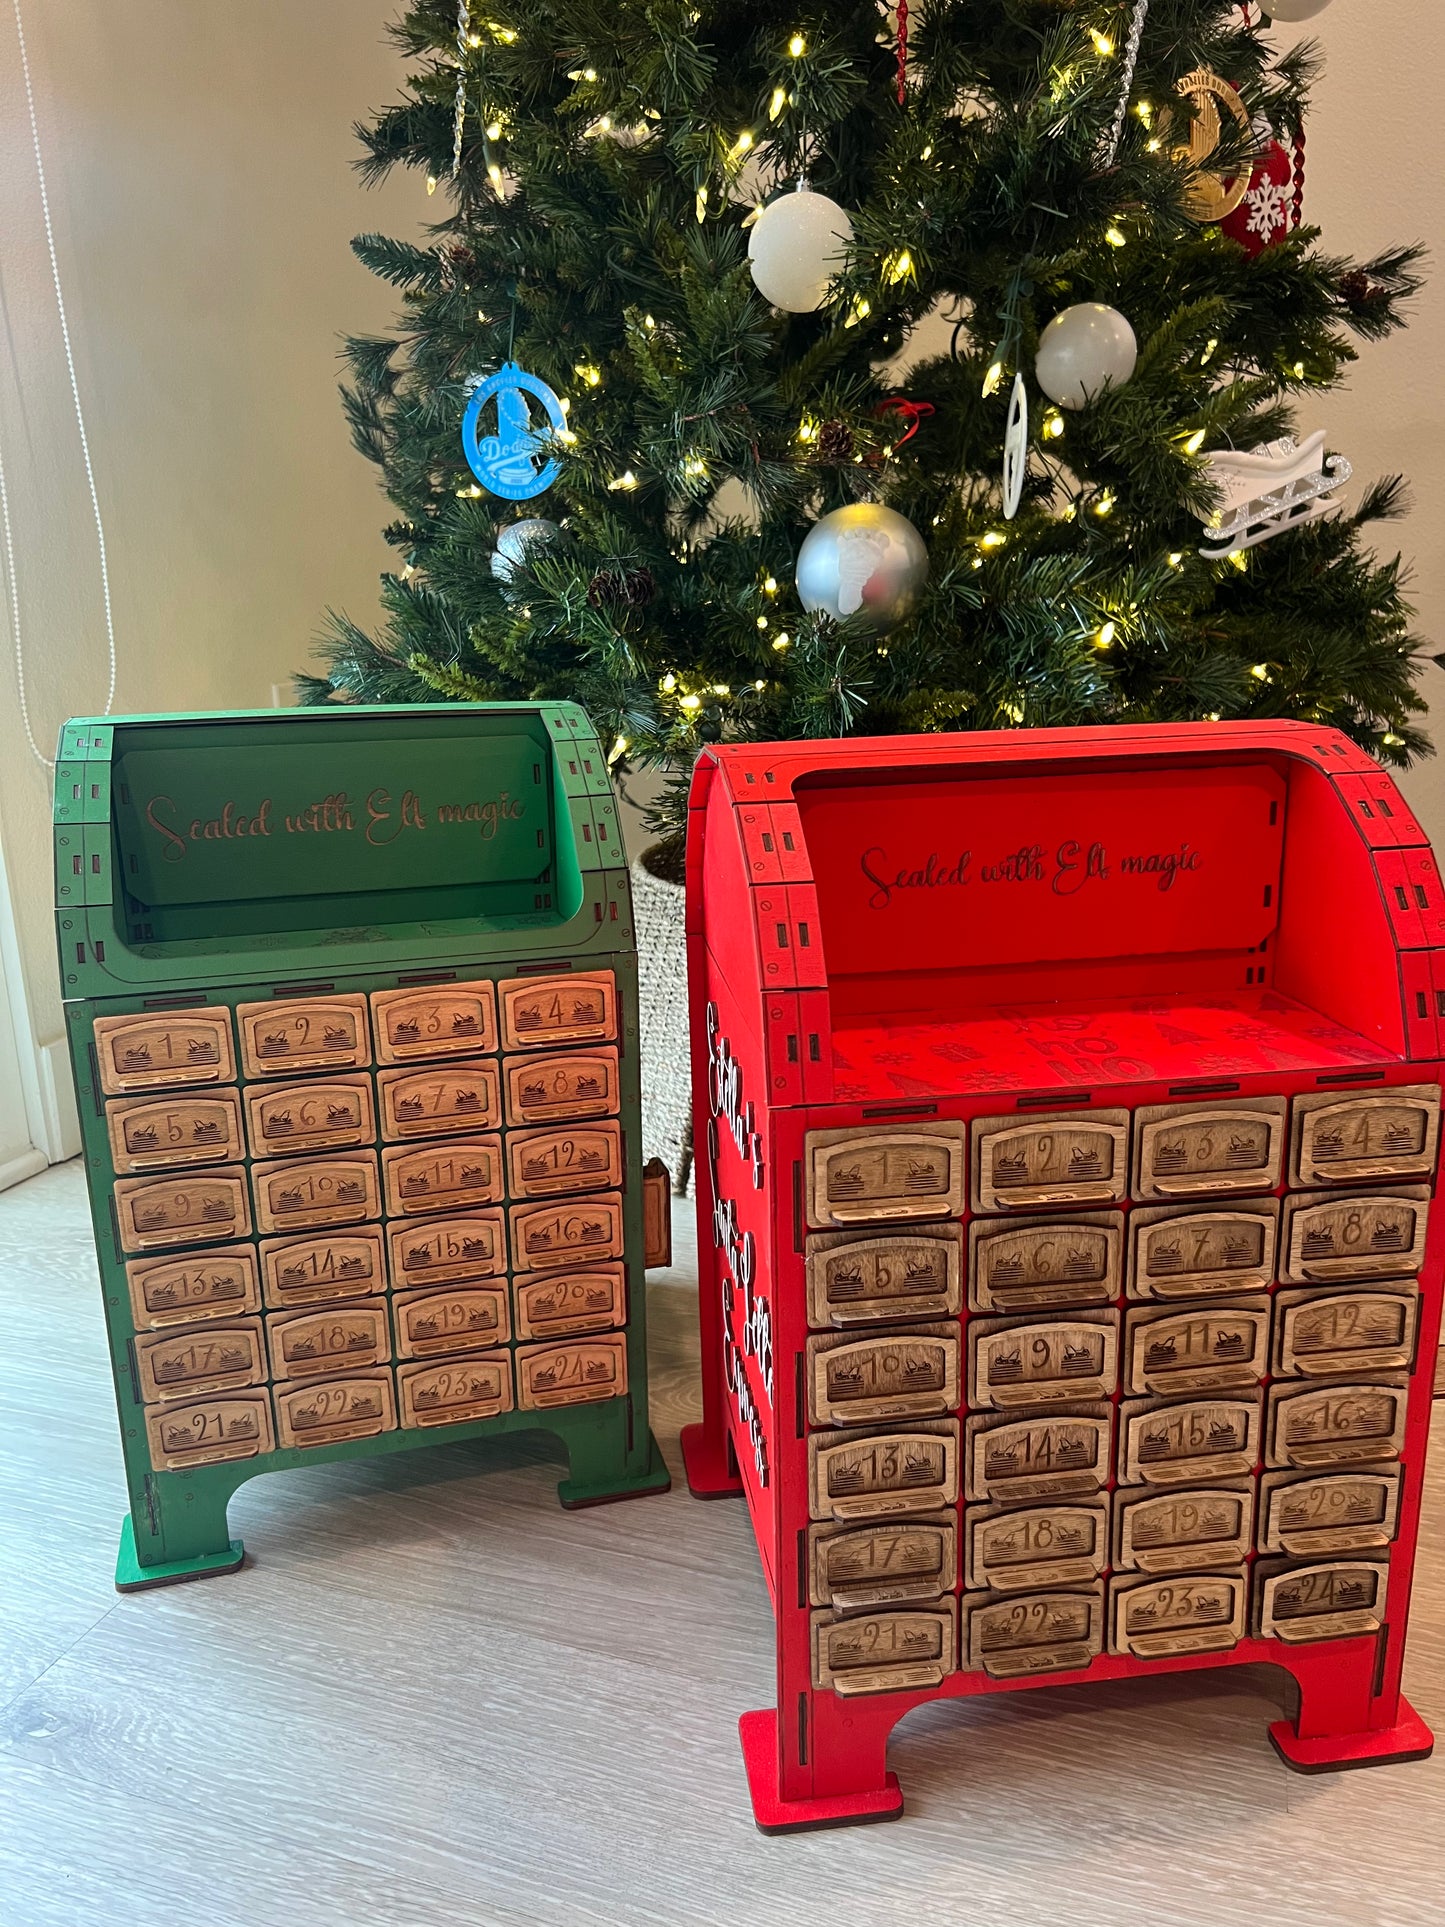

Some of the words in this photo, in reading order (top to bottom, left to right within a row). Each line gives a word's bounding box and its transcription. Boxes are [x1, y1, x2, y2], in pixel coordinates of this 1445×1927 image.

[146, 796, 274, 863] Sealed
[285, 792, 356, 833] with
[365, 788, 427, 846] Elf
[438, 792, 527, 841] magic
[861, 847, 972, 910] Sealed
[981, 844, 1047, 882] with
[1051, 840, 1112, 896] Elf
[1121, 843, 1202, 892] magic
[427, 1005, 441, 1033] 3
[549, 993, 564, 1025] 4
[157, 1033, 173, 1058] 1
[295, 1017, 311, 1046] 2
[554, 1069, 568, 1094] 8
[428, 1084, 446, 1111] 7
[167, 1114, 183, 1142] 5
[299, 1100, 316, 1127] 6
[1196, 1124, 1214, 1160] 3
[1352, 1112, 1372, 1153] 4
[549, 1140, 575, 1169] 12
[872, 1151, 888, 1185] 1
[1038, 1136, 1058, 1172] 2
[432, 1159, 455, 1186] 11
[302, 1176, 333, 1202] 10
[175, 1193, 191, 1217] 9
[552, 1216, 579, 1241] 16
[1342, 1213, 1361, 1245] 8
[433, 1232, 459, 1258] 15
[1033, 1241, 1054, 1274] 6
[1191, 1228, 1212, 1262] 7
[308, 1249, 338, 1277] 14
[874, 1254, 891, 1288] 5
[176, 1265, 207, 1298] 13
[557, 1283, 585, 1308] 20
[439, 1304, 464, 1329] 19
[1327, 1304, 1361, 1339] 12
[317, 1326, 345, 1354] 18
[1032, 1338, 1050, 1368] 9
[1179, 1323, 1209, 1354] 11
[186, 1343, 215, 1371] 17
[556, 1354, 585, 1380] 24
[861, 1353, 899, 1384] 10
[439, 1373, 468, 1398] 23
[318, 1390, 347, 1417] 22
[1316, 1401, 1355, 1431] 16
[194, 1412, 223, 1441] 21
[1169, 1415, 1204, 1446] 15
[1017, 1428, 1055, 1467] 14
[863, 1446, 899, 1481] 13
[1310, 1486, 1345, 1518] 20
[1163, 1504, 1199, 1533] 19
[1021, 1520, 1053, 1549] 18
[860, 1537, 900, 1568] 17
[1158, 1587, 1193, 1619] 23
[1301, 1571, 1337, 1605] 24
[1012, 1603, 1049, 1634] 22
[864, 1622, 898, 1655] 21
